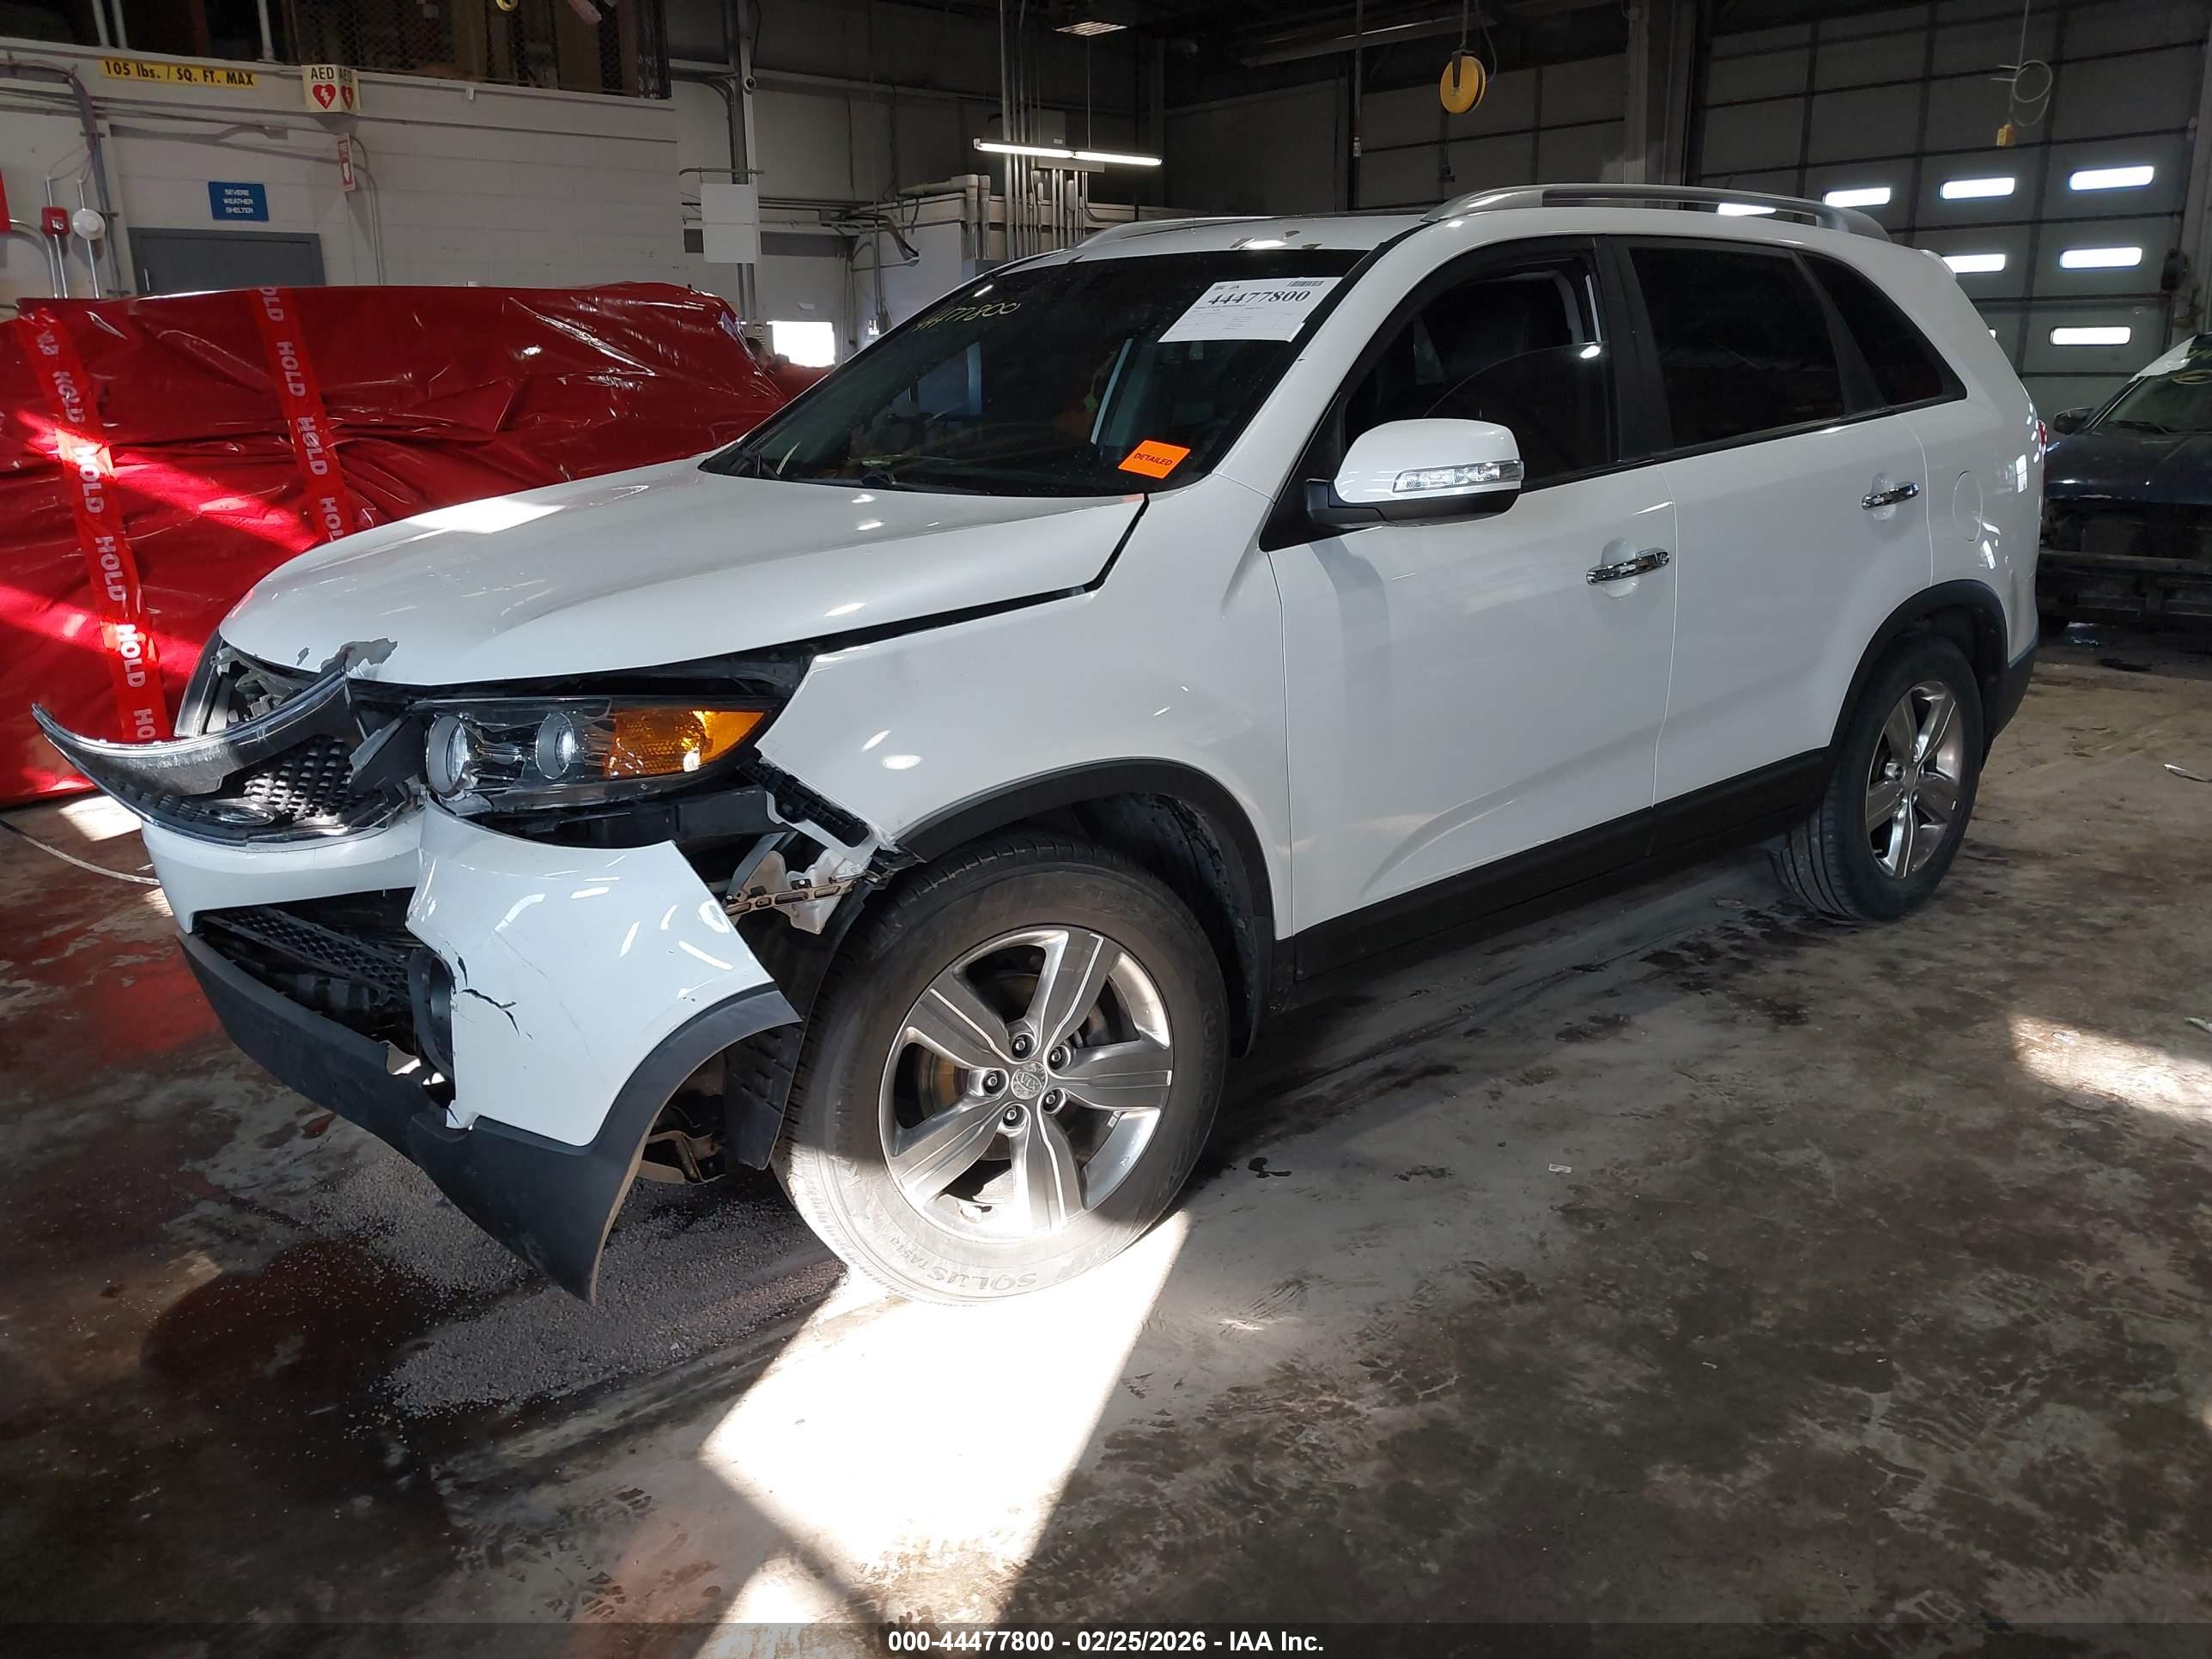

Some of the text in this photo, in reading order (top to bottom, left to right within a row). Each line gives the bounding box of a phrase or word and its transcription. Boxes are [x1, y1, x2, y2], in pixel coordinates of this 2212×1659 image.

[105, 60, 131, 76] 105
[137, 63, 161, 79] lbs.
[177, 67, 197, 83] SQ.
[203, 70, 221, 84] FT.
[226, 70, 254, 86] MAX
[310, 66, 335, 81] AED
[338, 68, 353, 83] AED
[1207, 289, 1311, 306] 44477800
[276, 340, 307, 398] HOLD
[52, 370, 86, 423] HOLD
[297, 416, 328, 476] HOLD
[1133, 453, 1173, 466] DETAILED
[74, 446, 105, 514] HOLD
[94, 536, 128, 602] HOLD
[116, 623, 146, 688] HOLD
[927, 1266, 1037, 1291] SOLUS
